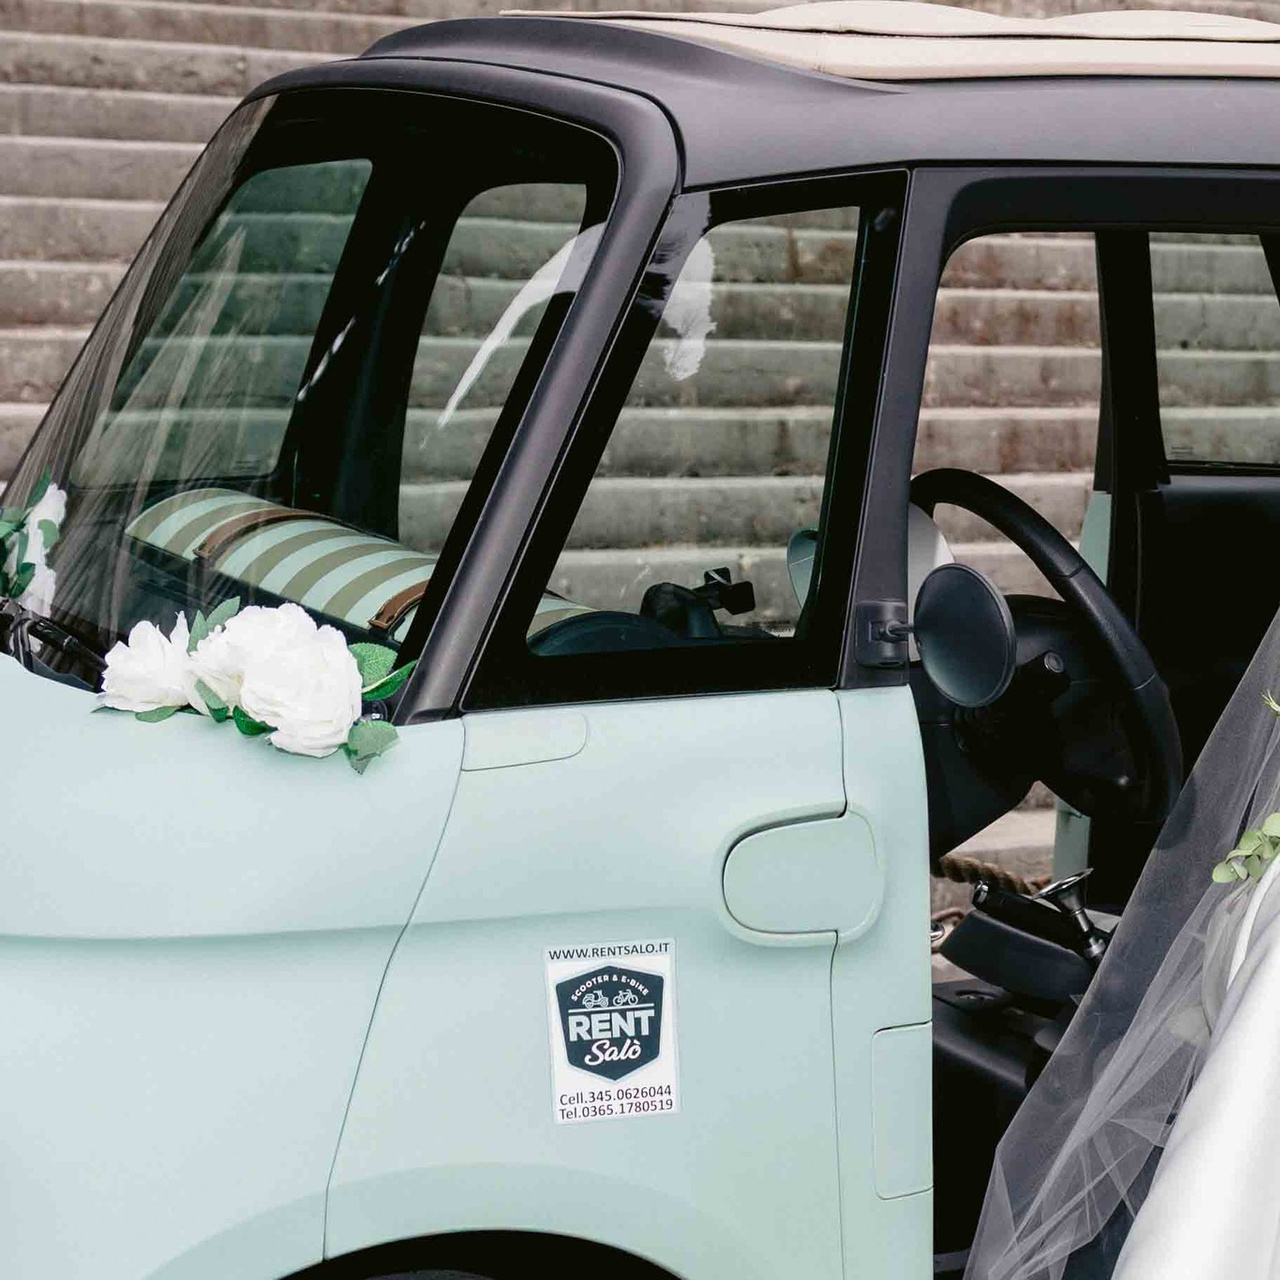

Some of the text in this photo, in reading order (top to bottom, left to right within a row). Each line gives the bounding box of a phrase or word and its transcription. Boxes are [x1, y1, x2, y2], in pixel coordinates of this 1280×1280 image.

[549, 942, 670, 960] WWW.RENTSALO.IT
[570, 973, 610, 1002] SCOOTER
[612, 973, 618, 982] &
[568, 1009, 655, 1042] RENT
[584, 1038, 642, 1066] Salò
[559, 1084, 672, 1106] Cell.345.0626044
[559, 1098, 674, 1121] Tel.0365.1780519
